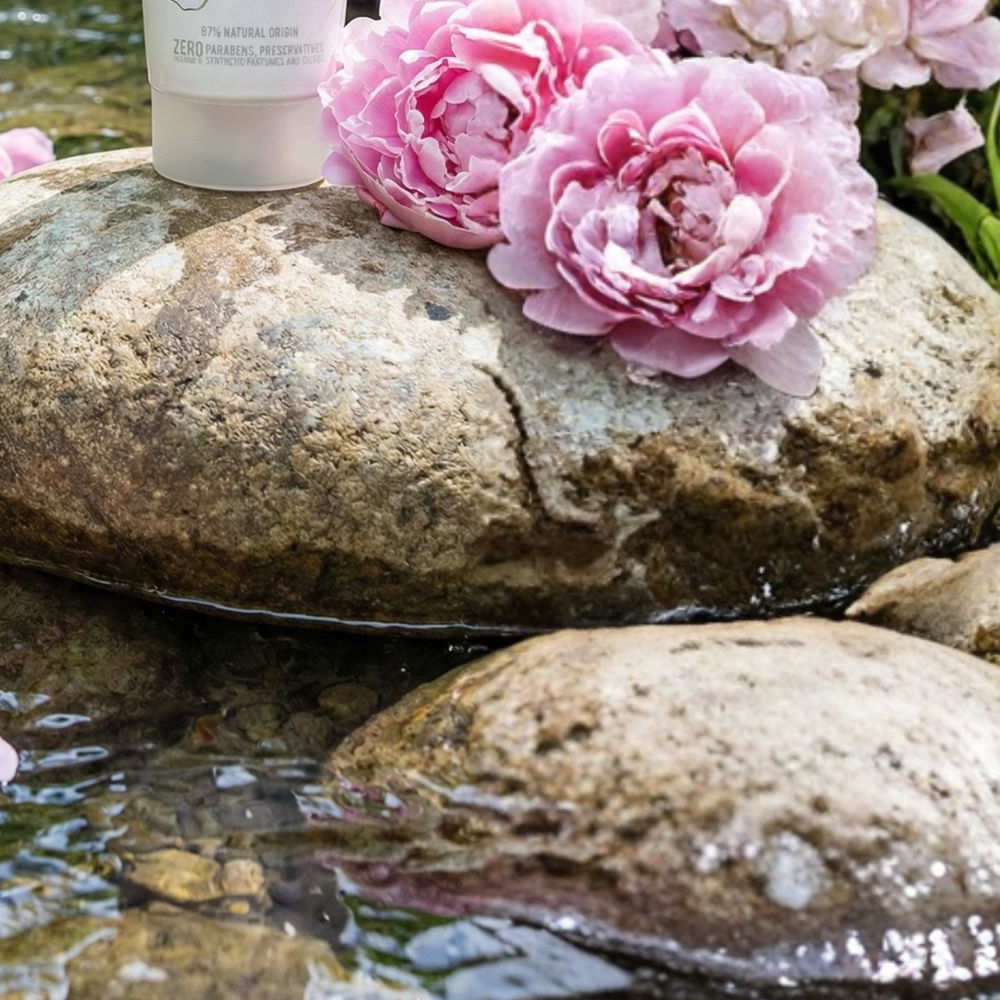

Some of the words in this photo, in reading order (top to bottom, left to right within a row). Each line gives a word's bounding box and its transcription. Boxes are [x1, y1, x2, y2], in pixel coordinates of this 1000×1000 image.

[224, 26, 266, 39] NATURAL
[269, 26, 299, 39] ORIGIN
[173, 39, 203, 57] ZERO
[206, 44, 257, 57] PARABENS,
